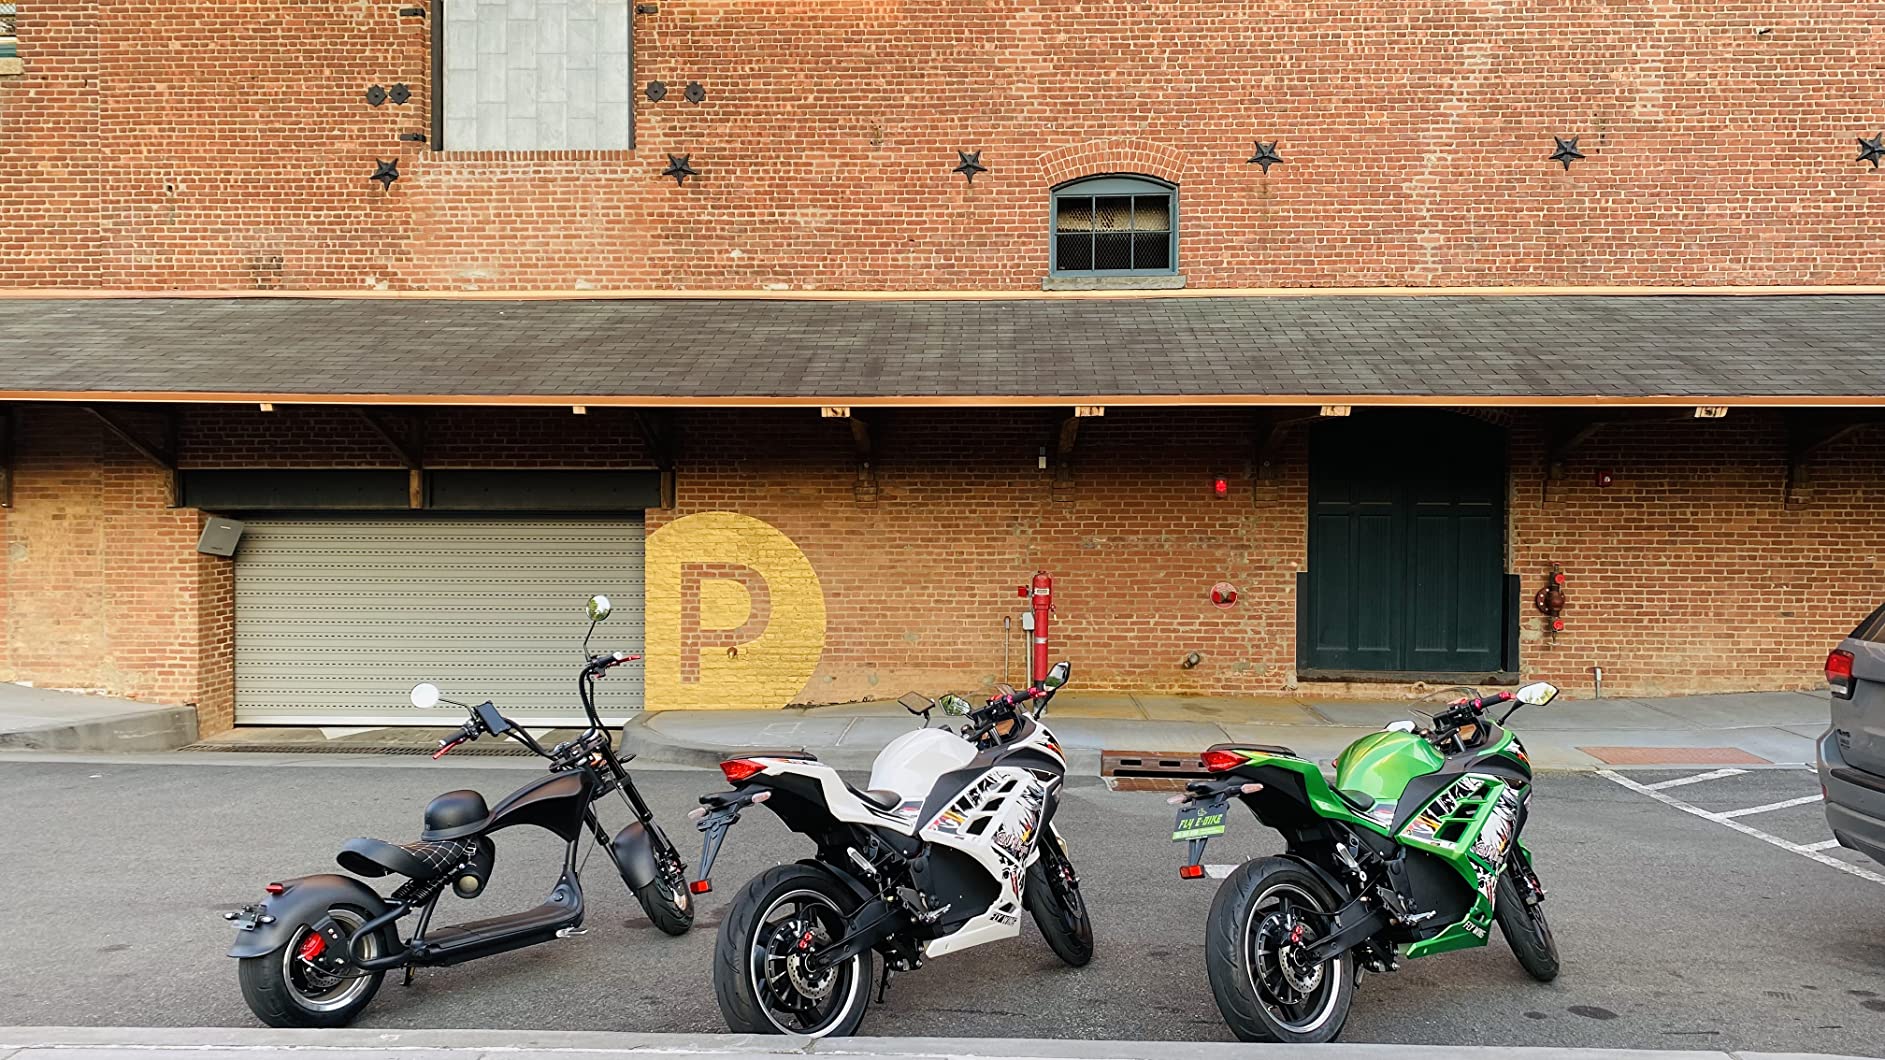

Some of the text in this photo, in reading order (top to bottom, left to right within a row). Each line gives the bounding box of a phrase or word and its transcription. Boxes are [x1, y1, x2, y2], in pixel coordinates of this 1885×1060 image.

[680, 562, 771, 683] P
[1178, 814, 1224, 830] FLY E-BIKE
